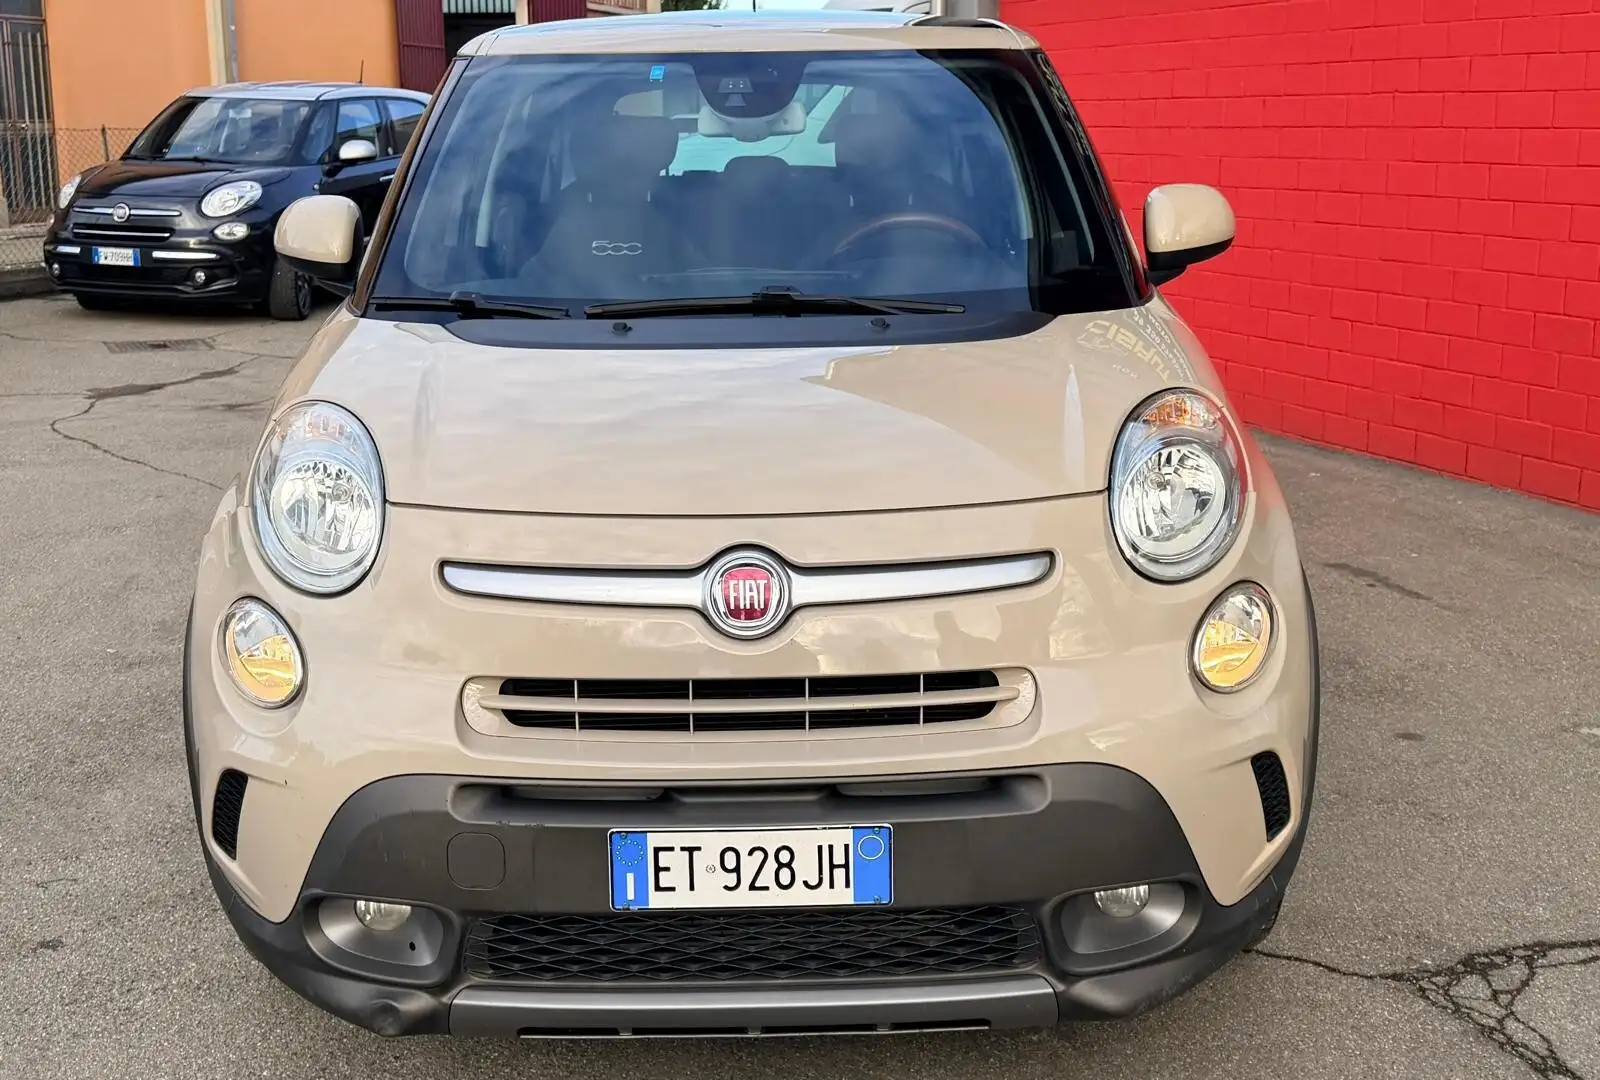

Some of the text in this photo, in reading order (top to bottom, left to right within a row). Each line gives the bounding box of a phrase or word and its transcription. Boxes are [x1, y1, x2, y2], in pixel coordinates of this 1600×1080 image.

[592, 240, 642, 256] 500
[728, 579, 768, 610] FIAT
[653, 843, 851, 892] ET 928JH
